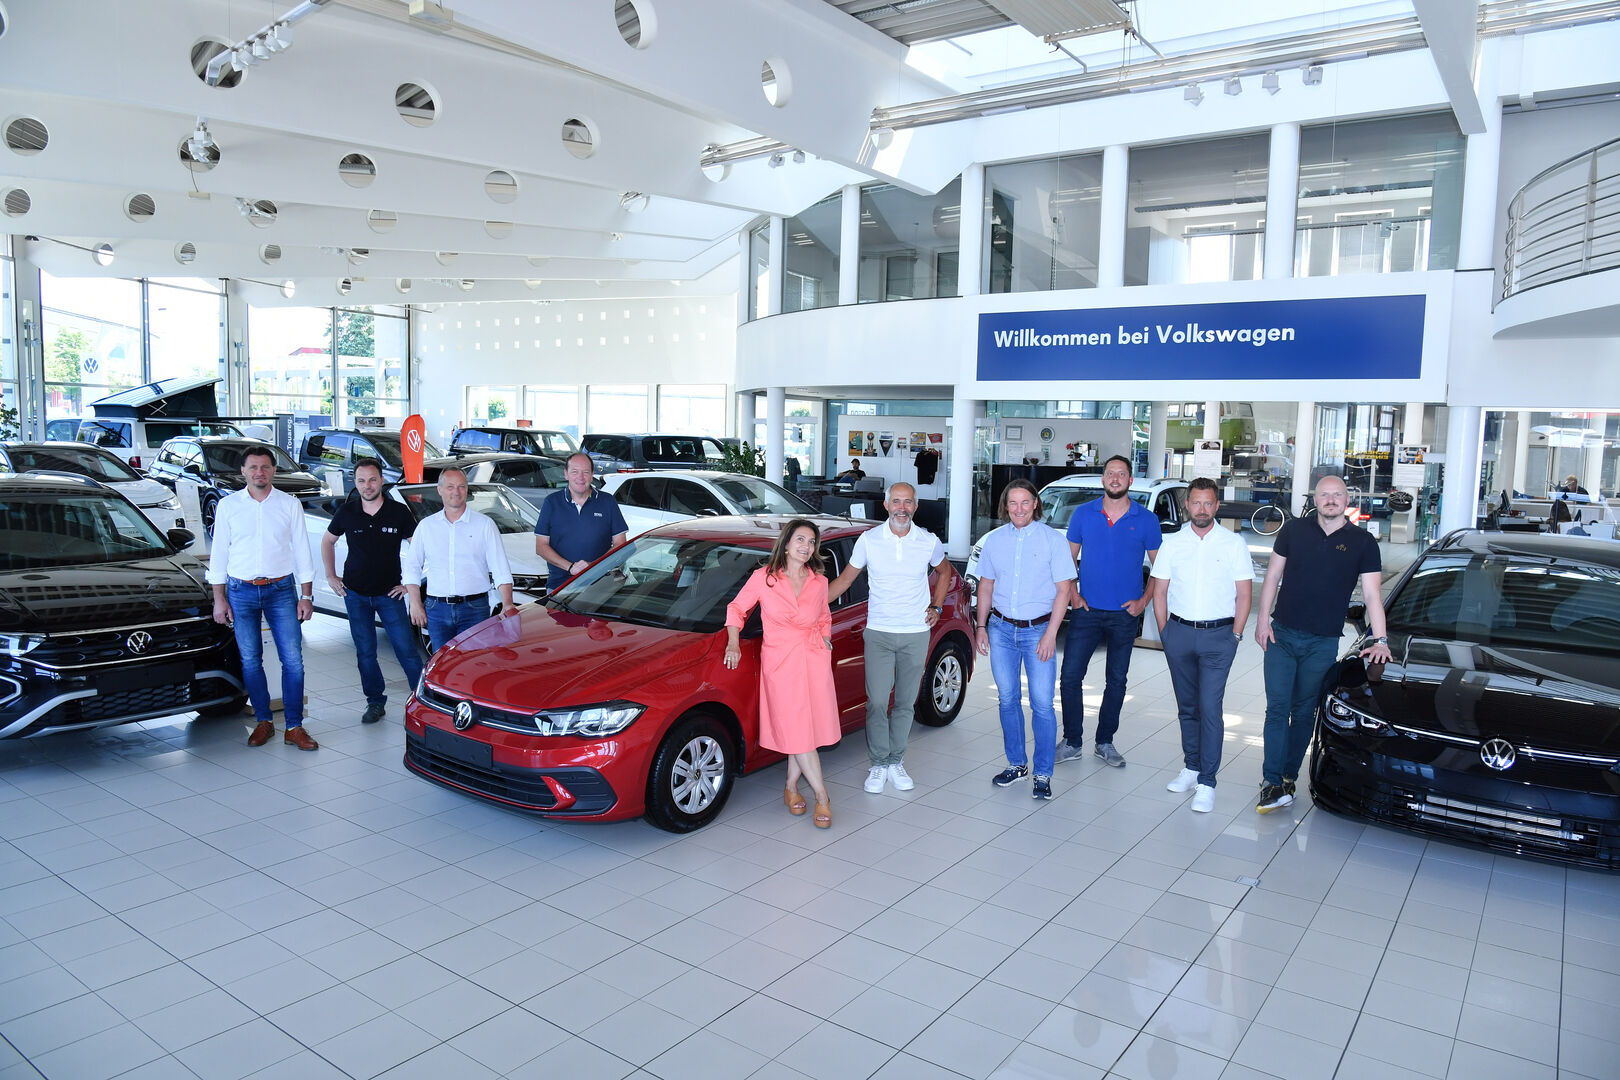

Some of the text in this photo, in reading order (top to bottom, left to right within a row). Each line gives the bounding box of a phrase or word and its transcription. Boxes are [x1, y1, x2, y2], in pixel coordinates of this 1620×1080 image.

[993, 322, 1295, 348] Willkommen bei Volkswagen
